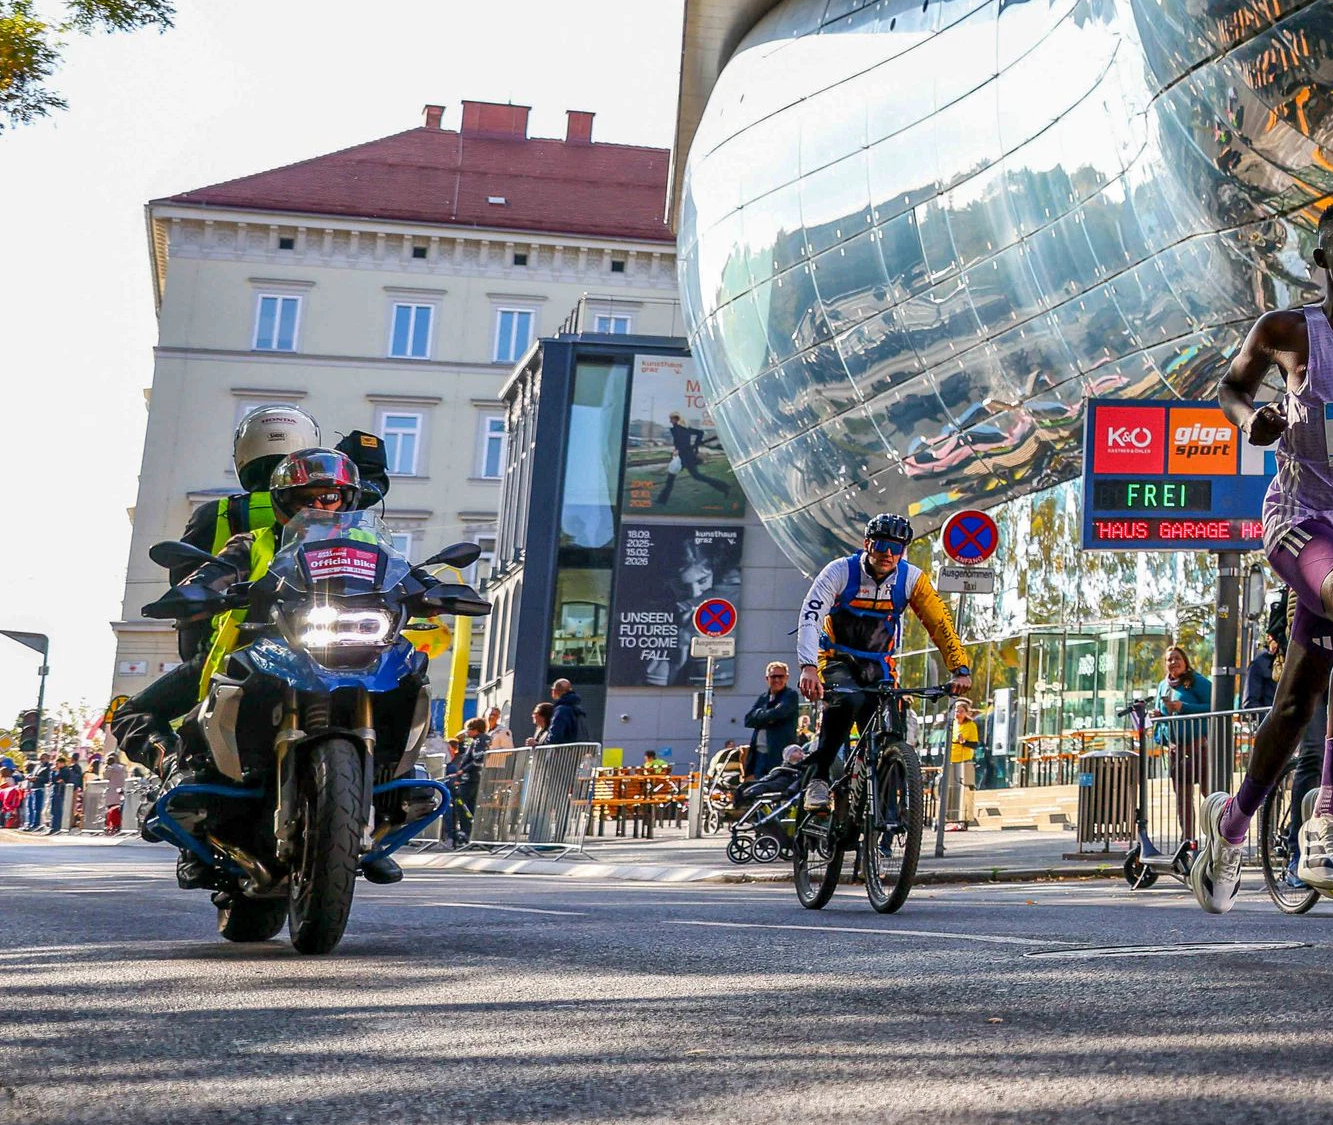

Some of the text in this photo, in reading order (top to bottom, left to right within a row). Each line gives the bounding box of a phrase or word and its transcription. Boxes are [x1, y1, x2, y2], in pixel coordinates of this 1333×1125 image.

[1174, 423, 1232, 445] giga
[1175, 444, 1230, 458] sport
[1127, 484, 1186, 508] FREI
[627, 530, 737, 539] 18.09. kunsthaus
[1159, 522, 1231, 539] GARAGE
[694, 537, 712, 545] graz
[625, 548, 649, 557] 15.02.
[310, 557, 376, 569] Official Bike
[624, 557, 648, 566] 2026
[955, 555, 984, 565] ANFANG
[942, 567, 993, 580] Ausgenommen
[963, 580, 977, 591] Taxi
[620, 612, 674, 623] UNSEEN
[620, 624, 678, 636] FUTURES
[618, 637, 677, 648] TO COME
[640, 650, 671, 661] FALL
